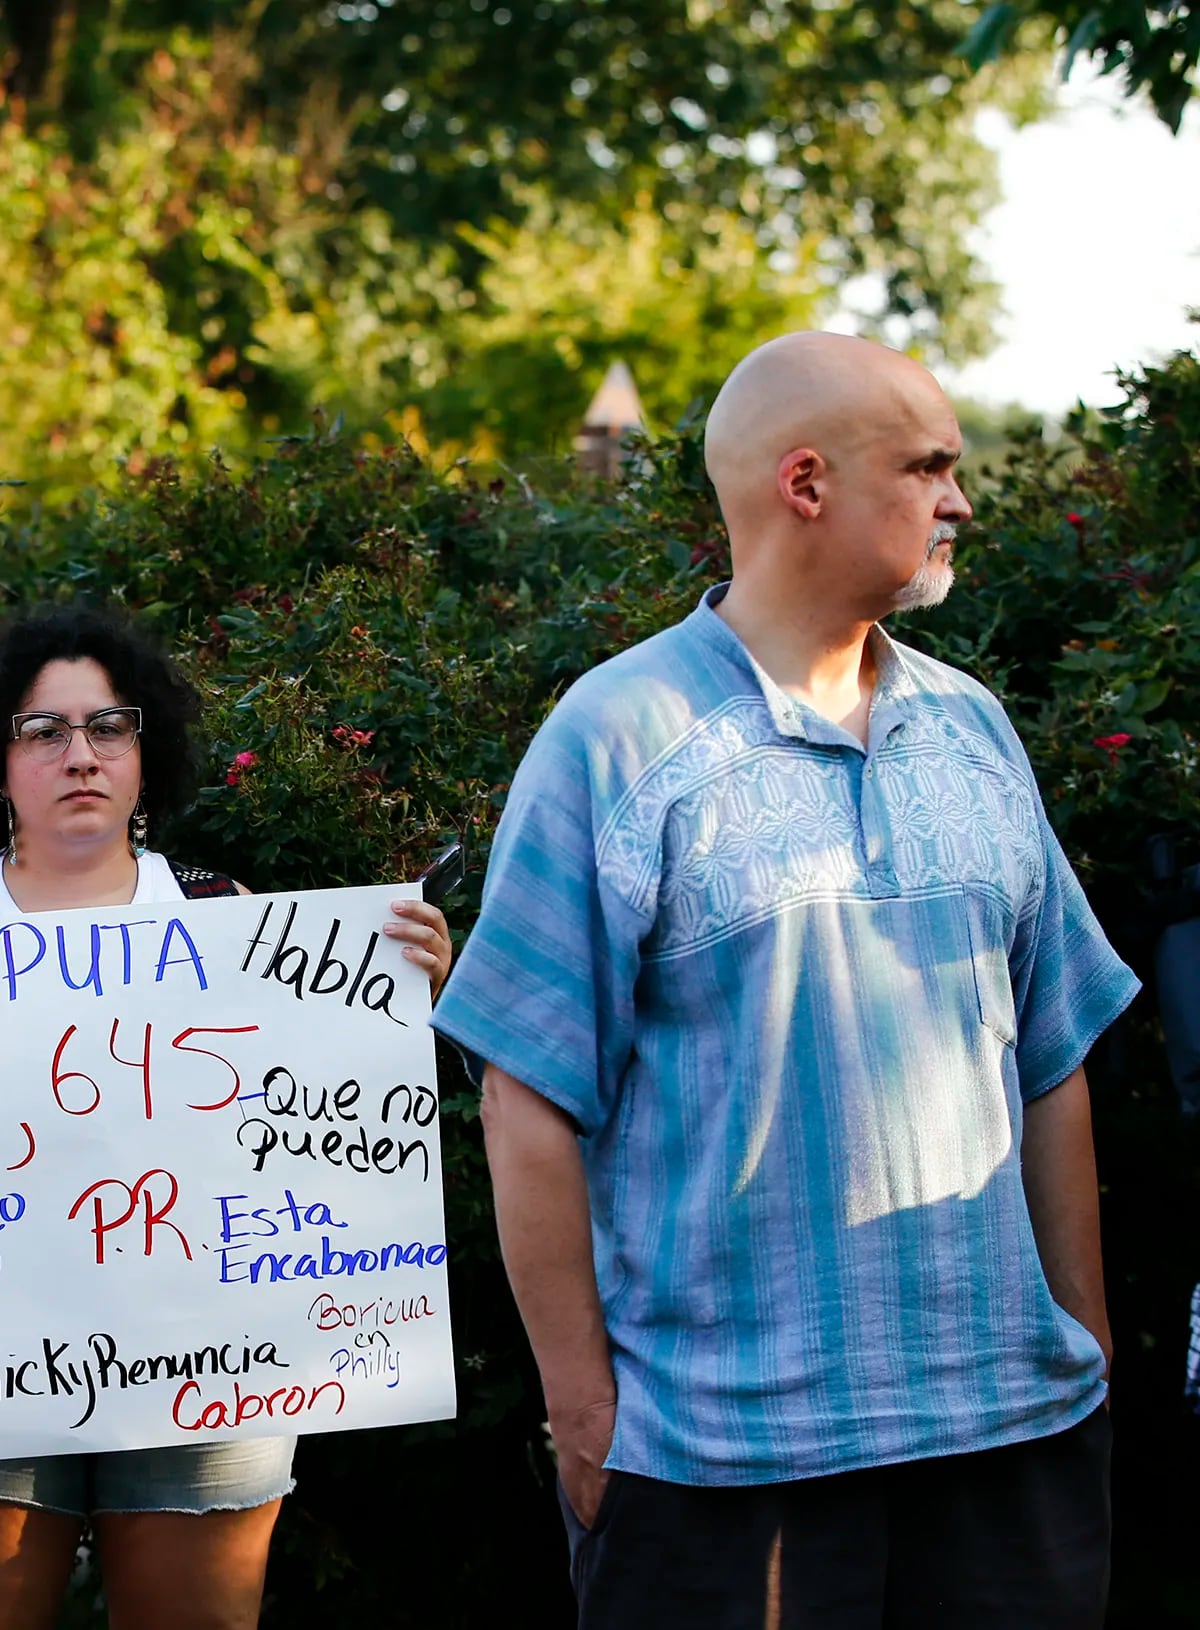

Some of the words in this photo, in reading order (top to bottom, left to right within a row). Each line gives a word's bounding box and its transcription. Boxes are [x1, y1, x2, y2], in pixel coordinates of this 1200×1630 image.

[241, 900, 410, 1028] Habla
[381, 1084, 439, 1128] no
[211, 1189, 350, 1244] Esta
[308, 1293, 436, 1330] Boricua
[354, 1330, 391, 1349] en
[330, 1346, 400, 1388] Philly
[172, 1380, 345, 1430] Cabron
